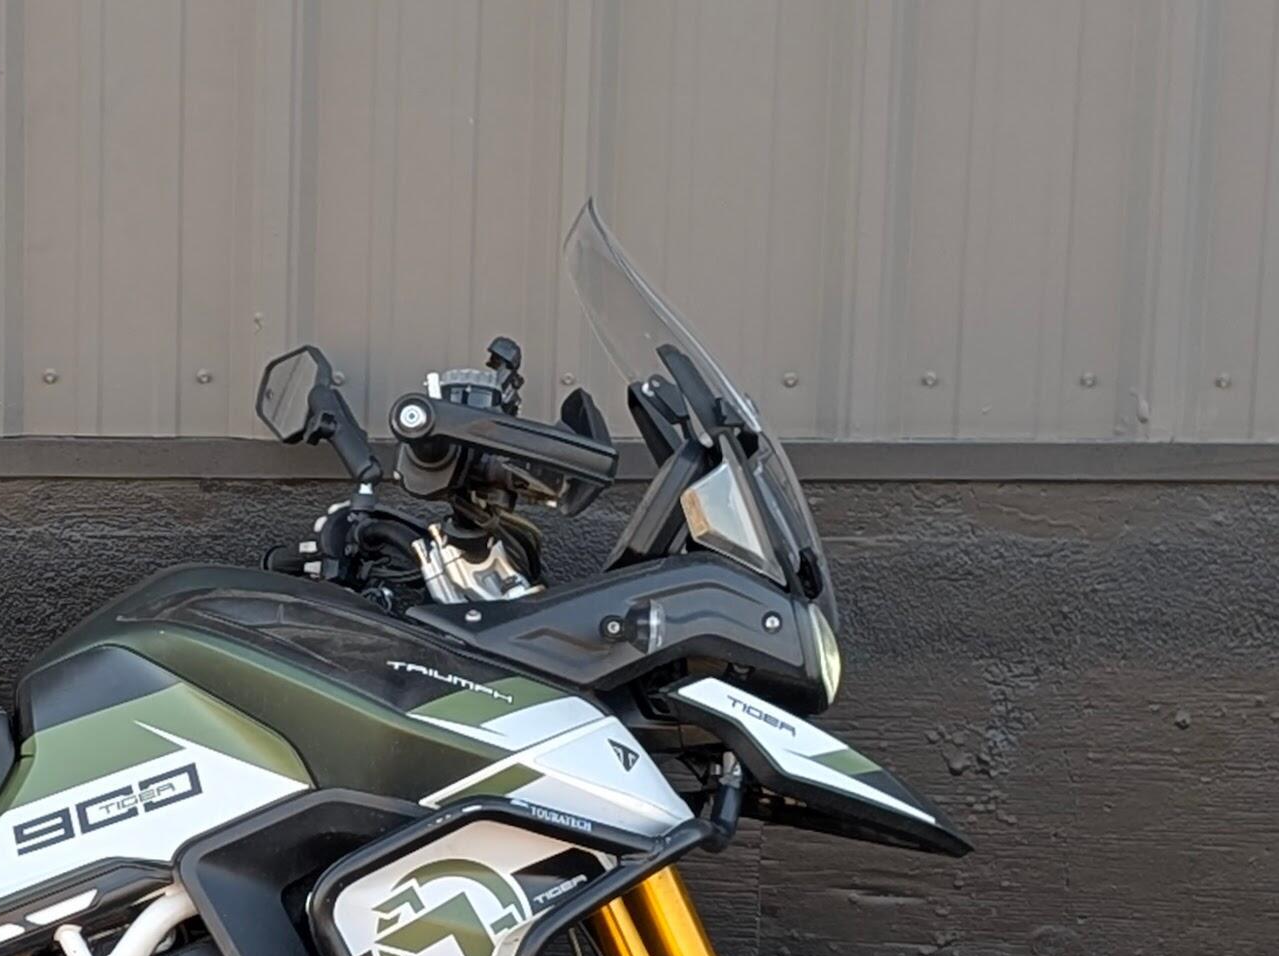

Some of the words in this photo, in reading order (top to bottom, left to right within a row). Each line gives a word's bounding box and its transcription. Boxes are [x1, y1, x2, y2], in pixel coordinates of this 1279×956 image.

[387, 660, 513, 704] TRIUMPH
[727, 695, 796, 737] TIGER
[13, 762, 203, 856] 900
[99, 782, 176, 815] TIGER
[529, 806, 593, 832] TOURATECH
[534, 874, 588, 904] TIGER
